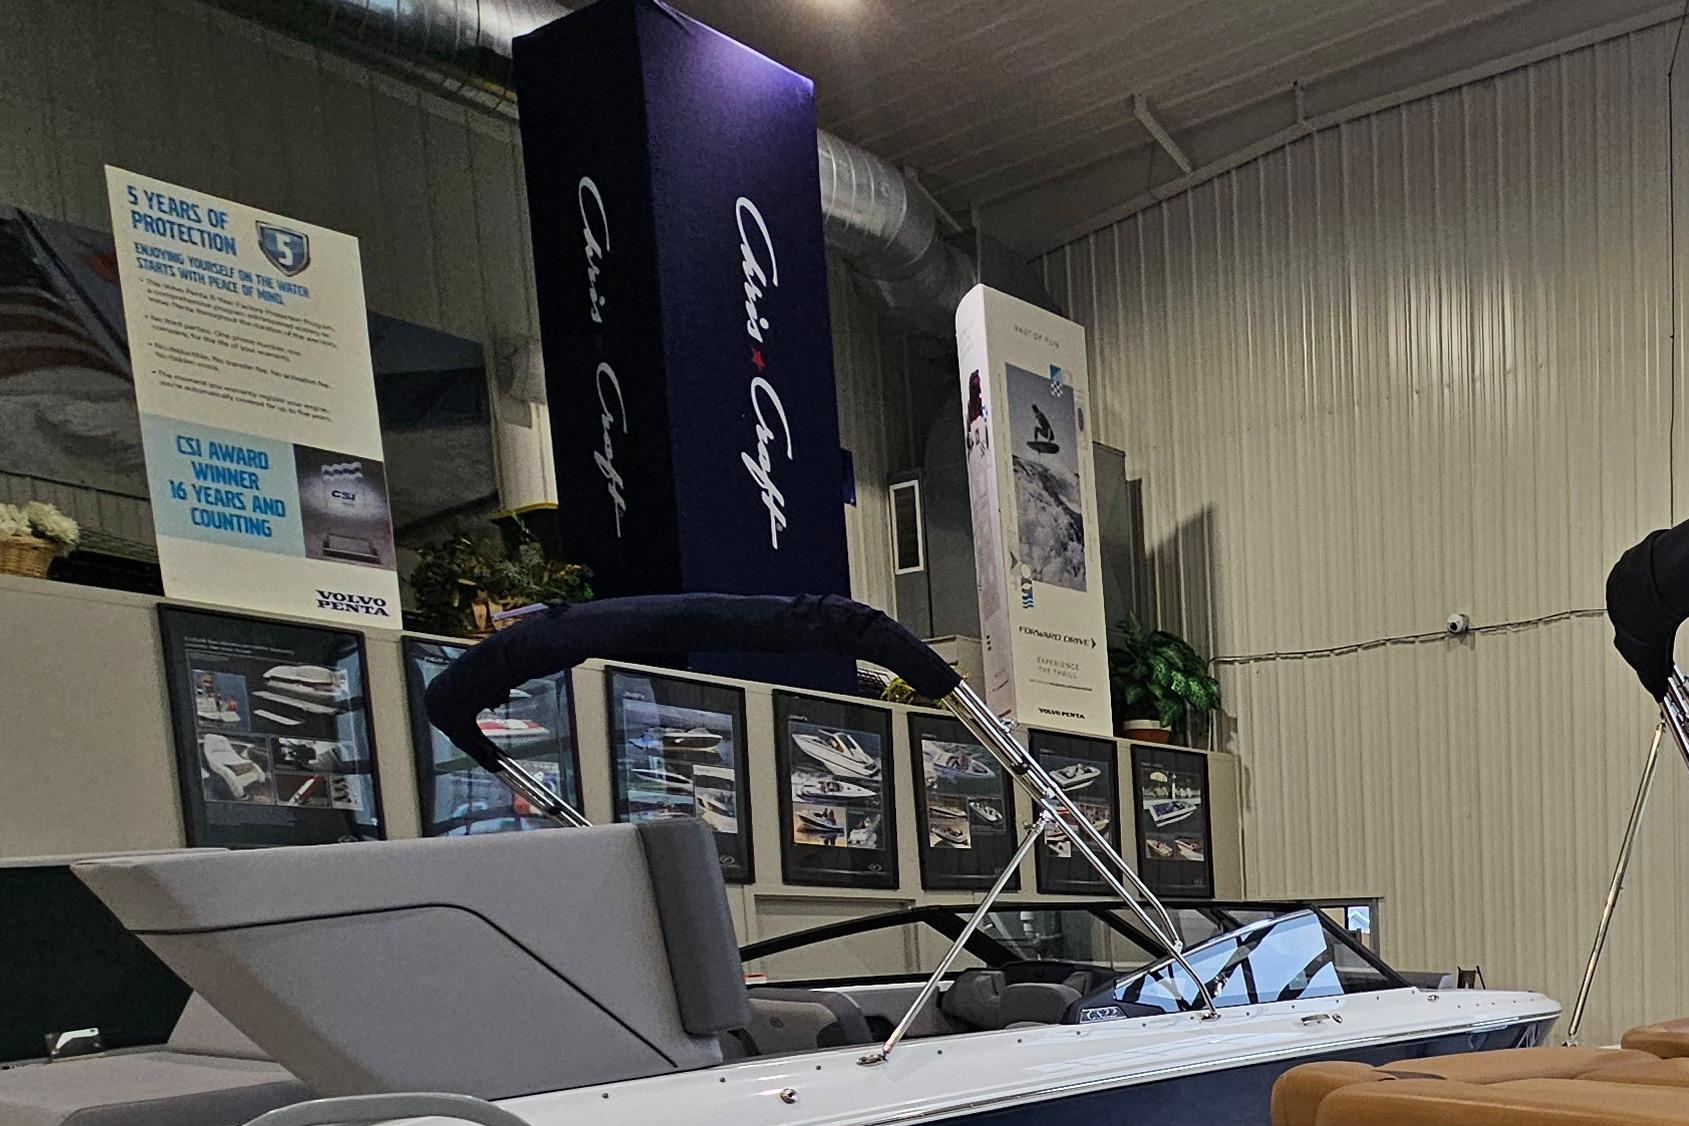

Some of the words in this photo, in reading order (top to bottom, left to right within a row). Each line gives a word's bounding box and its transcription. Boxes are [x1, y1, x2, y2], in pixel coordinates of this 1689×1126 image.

[127, 185, 138, 205] 5
[144, 189, 202, 224] YEARS
[208, 208, 228, 230] OF
[131, 210, 237, 256] PROTECTION
[276, 233, 293, 266] 5
[579, 176, 610, 322] Chris
[133, 242, 184, 265] ENJOYING
[188, 254, 234, 279] YOURSELF
[238, 269, 253, 283] ON
[256, 274, 274, 289] THE
[277, 280, 310, 299] WATER
[136, 257, 175, 278] STARTS
[179, 268, 206, 286] WITH
[208, 276, 238, 295] PEACE
[242, 285, 256, 297] OF
[736, 197, 777, 343] Chris
[176, 435, 201, 457] CSI
[209, 441, 269, 470] AWARD
[594, 362, 628, 538] Craft
[741, 376, 792, 549] Craft
[190, 461, 259, 490] WINNER
[169, 480, 187, 500] 16
[192, 485, 245, 510] YEARS
[253, 499, 285, 517] AND
[331, 490, 355, 500] CSI
[191, 507, 272, 538] COUNTING
[316, 590, 387, 607] VOLVO
[316, 599, 390, 617] PENTA
[1019, 626, 1061, 641] FORWARD
[1064, 636, 1090, 646] DRIVE
[1062, 711, 1085, 719] PENTA
